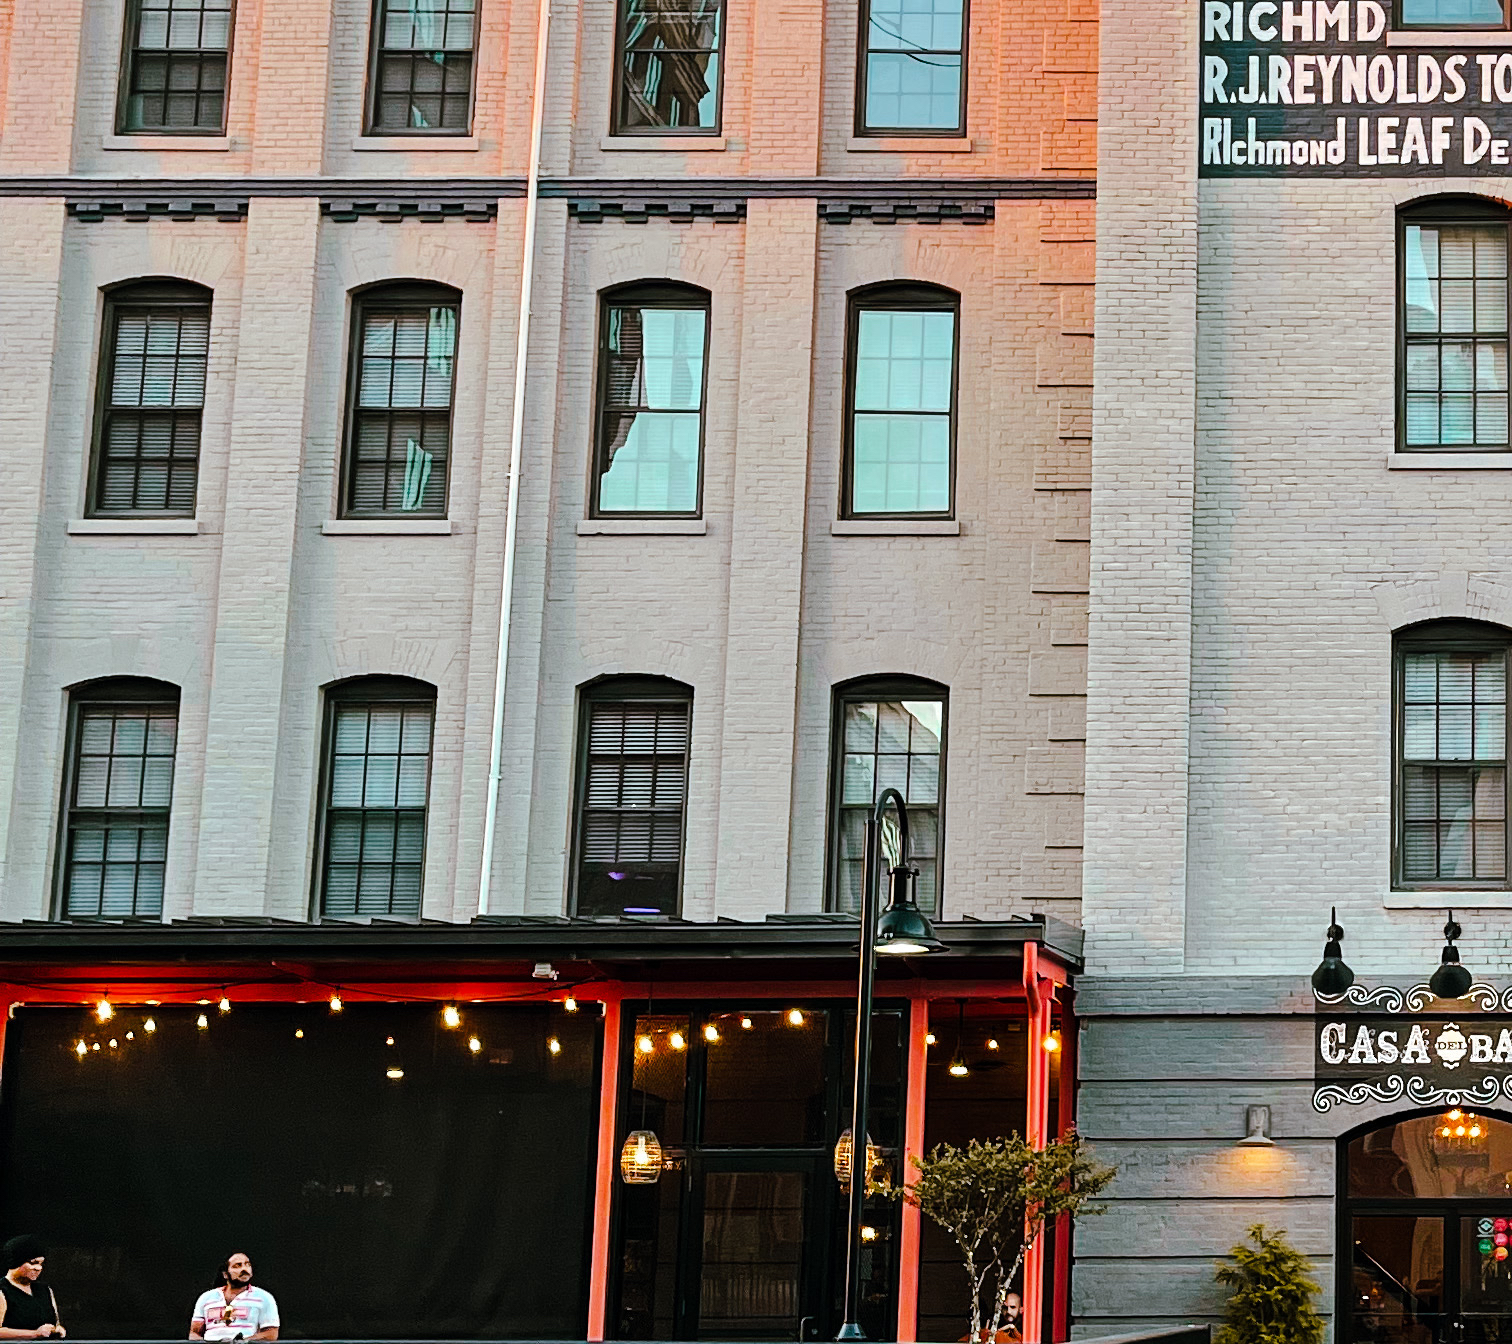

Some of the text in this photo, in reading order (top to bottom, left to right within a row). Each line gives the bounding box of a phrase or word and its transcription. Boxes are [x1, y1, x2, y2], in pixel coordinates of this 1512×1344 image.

[1204, 0, 1387, 42] RICHMD
[1358, 116, 1455, 166] LEAF
[1320, 1022, 1432, 1064] CASA
[1437, 1041, 1465, 1050] DEL
